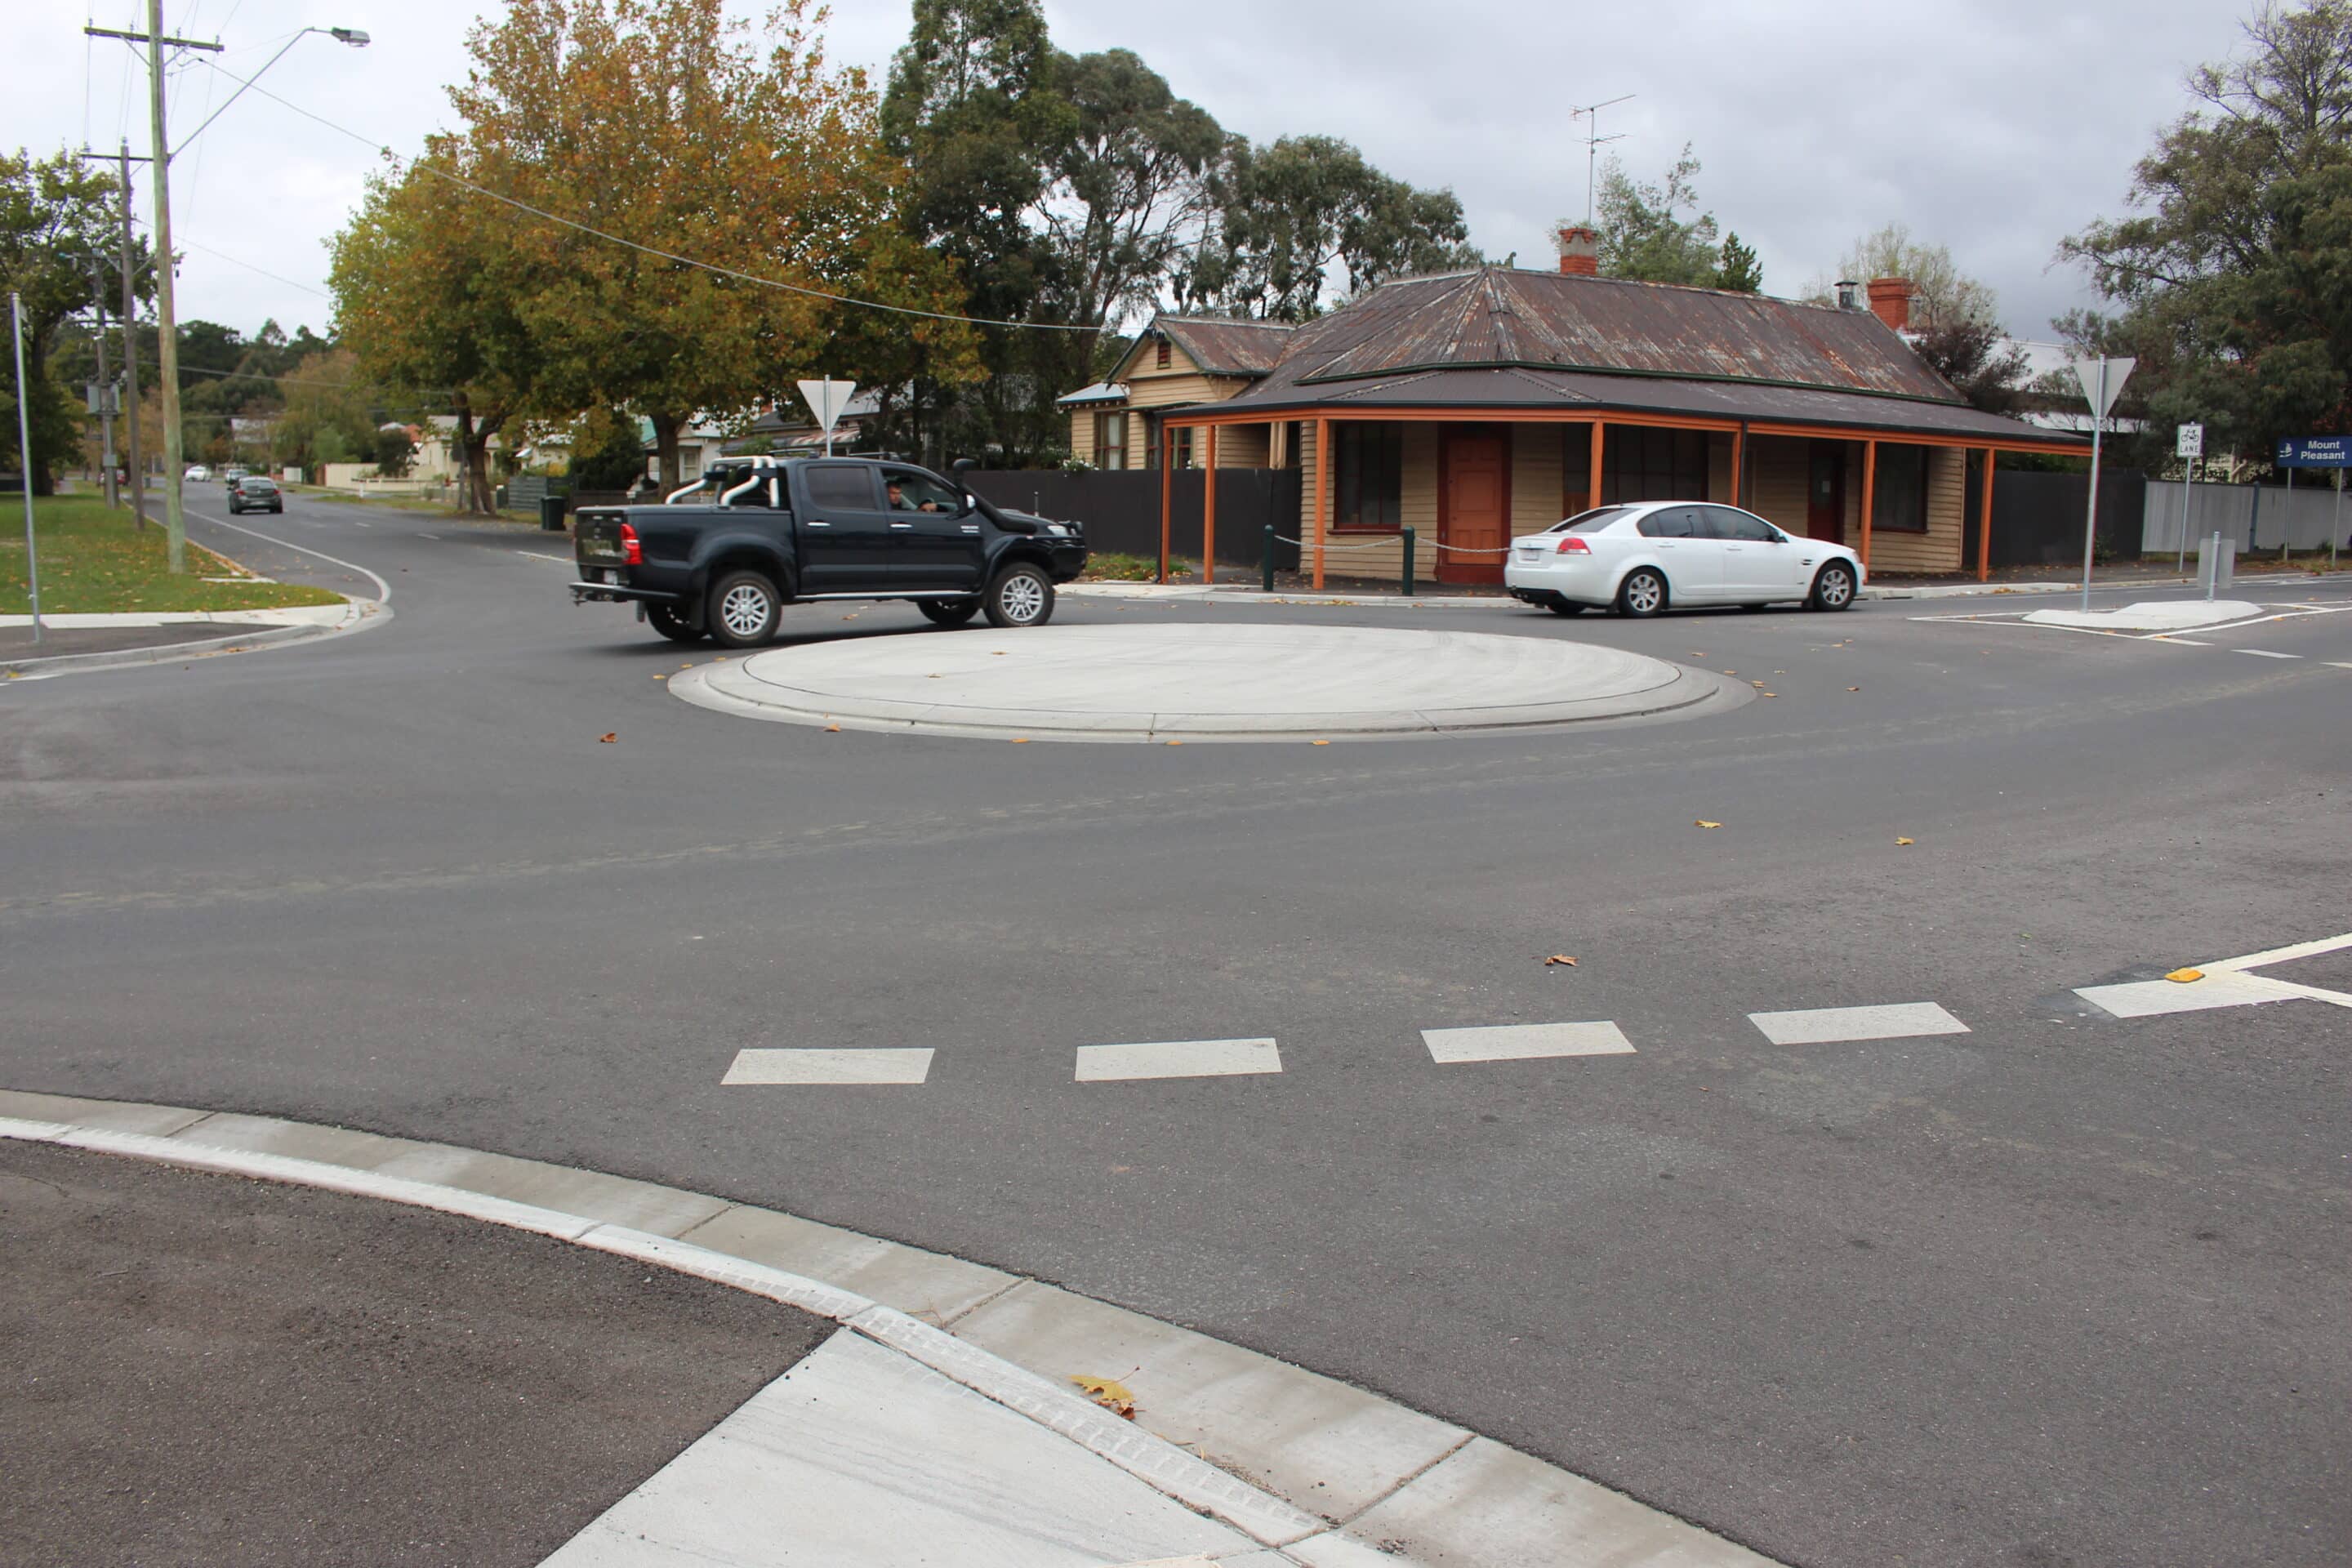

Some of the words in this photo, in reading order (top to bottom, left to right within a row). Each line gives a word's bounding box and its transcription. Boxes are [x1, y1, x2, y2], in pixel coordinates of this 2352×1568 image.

[2180, 444, 2198, 452] LANE
[2308, 440, 2340, 449] Mount
[2300, 451, 2345, 460] Pleasant
